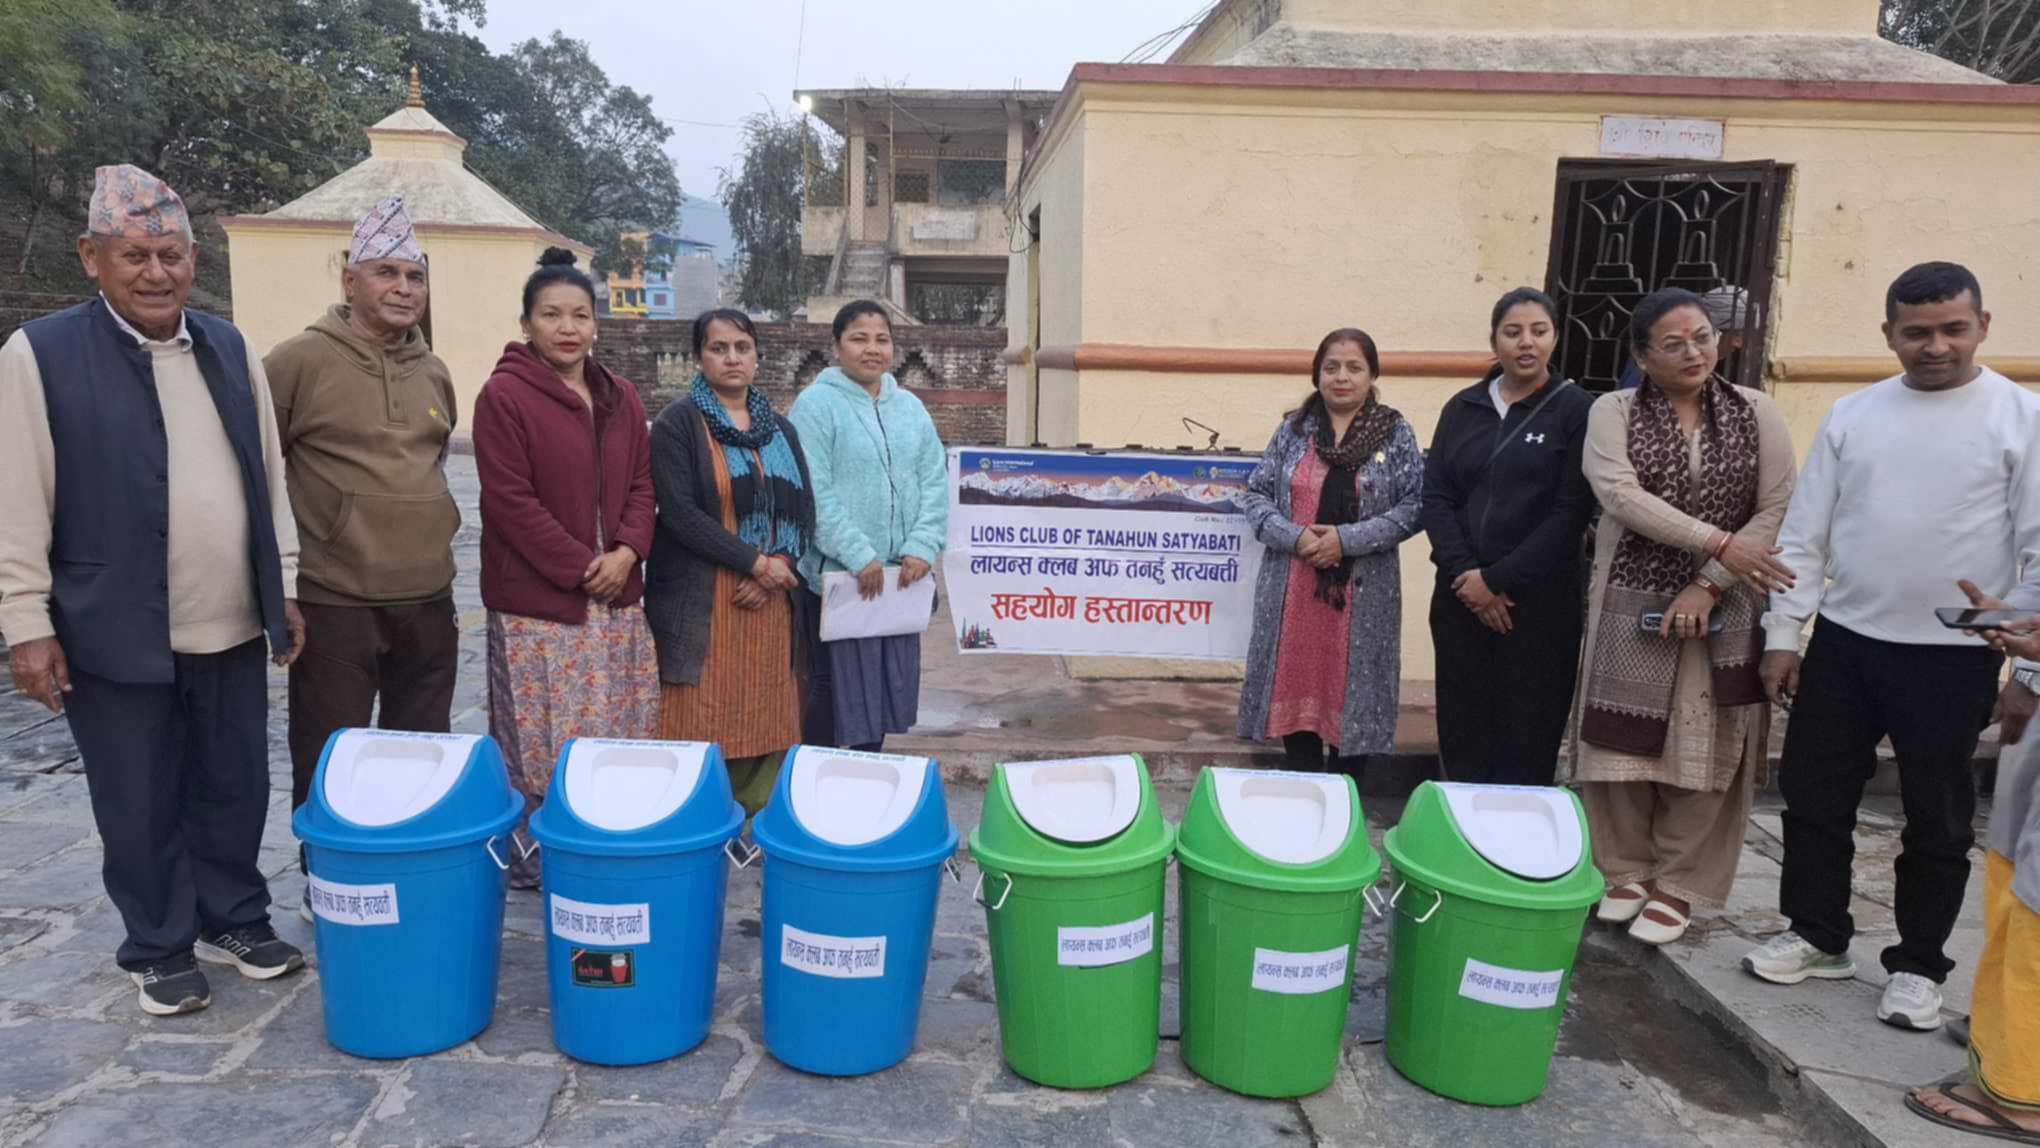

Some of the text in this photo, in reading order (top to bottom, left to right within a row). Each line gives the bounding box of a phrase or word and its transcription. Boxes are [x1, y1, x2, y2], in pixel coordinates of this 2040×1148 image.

[970, 525, 1240, 553] LIONS CLUB OF TANAHUN SATYABATI
[970, 555, 1033, 576] लायन्स
[1038, 556, 1078, 577] क्लब
[1084, 558, 1121, 578] अफ
[990, 586, 1214, 626] सहयोग हस्तान्तरण
